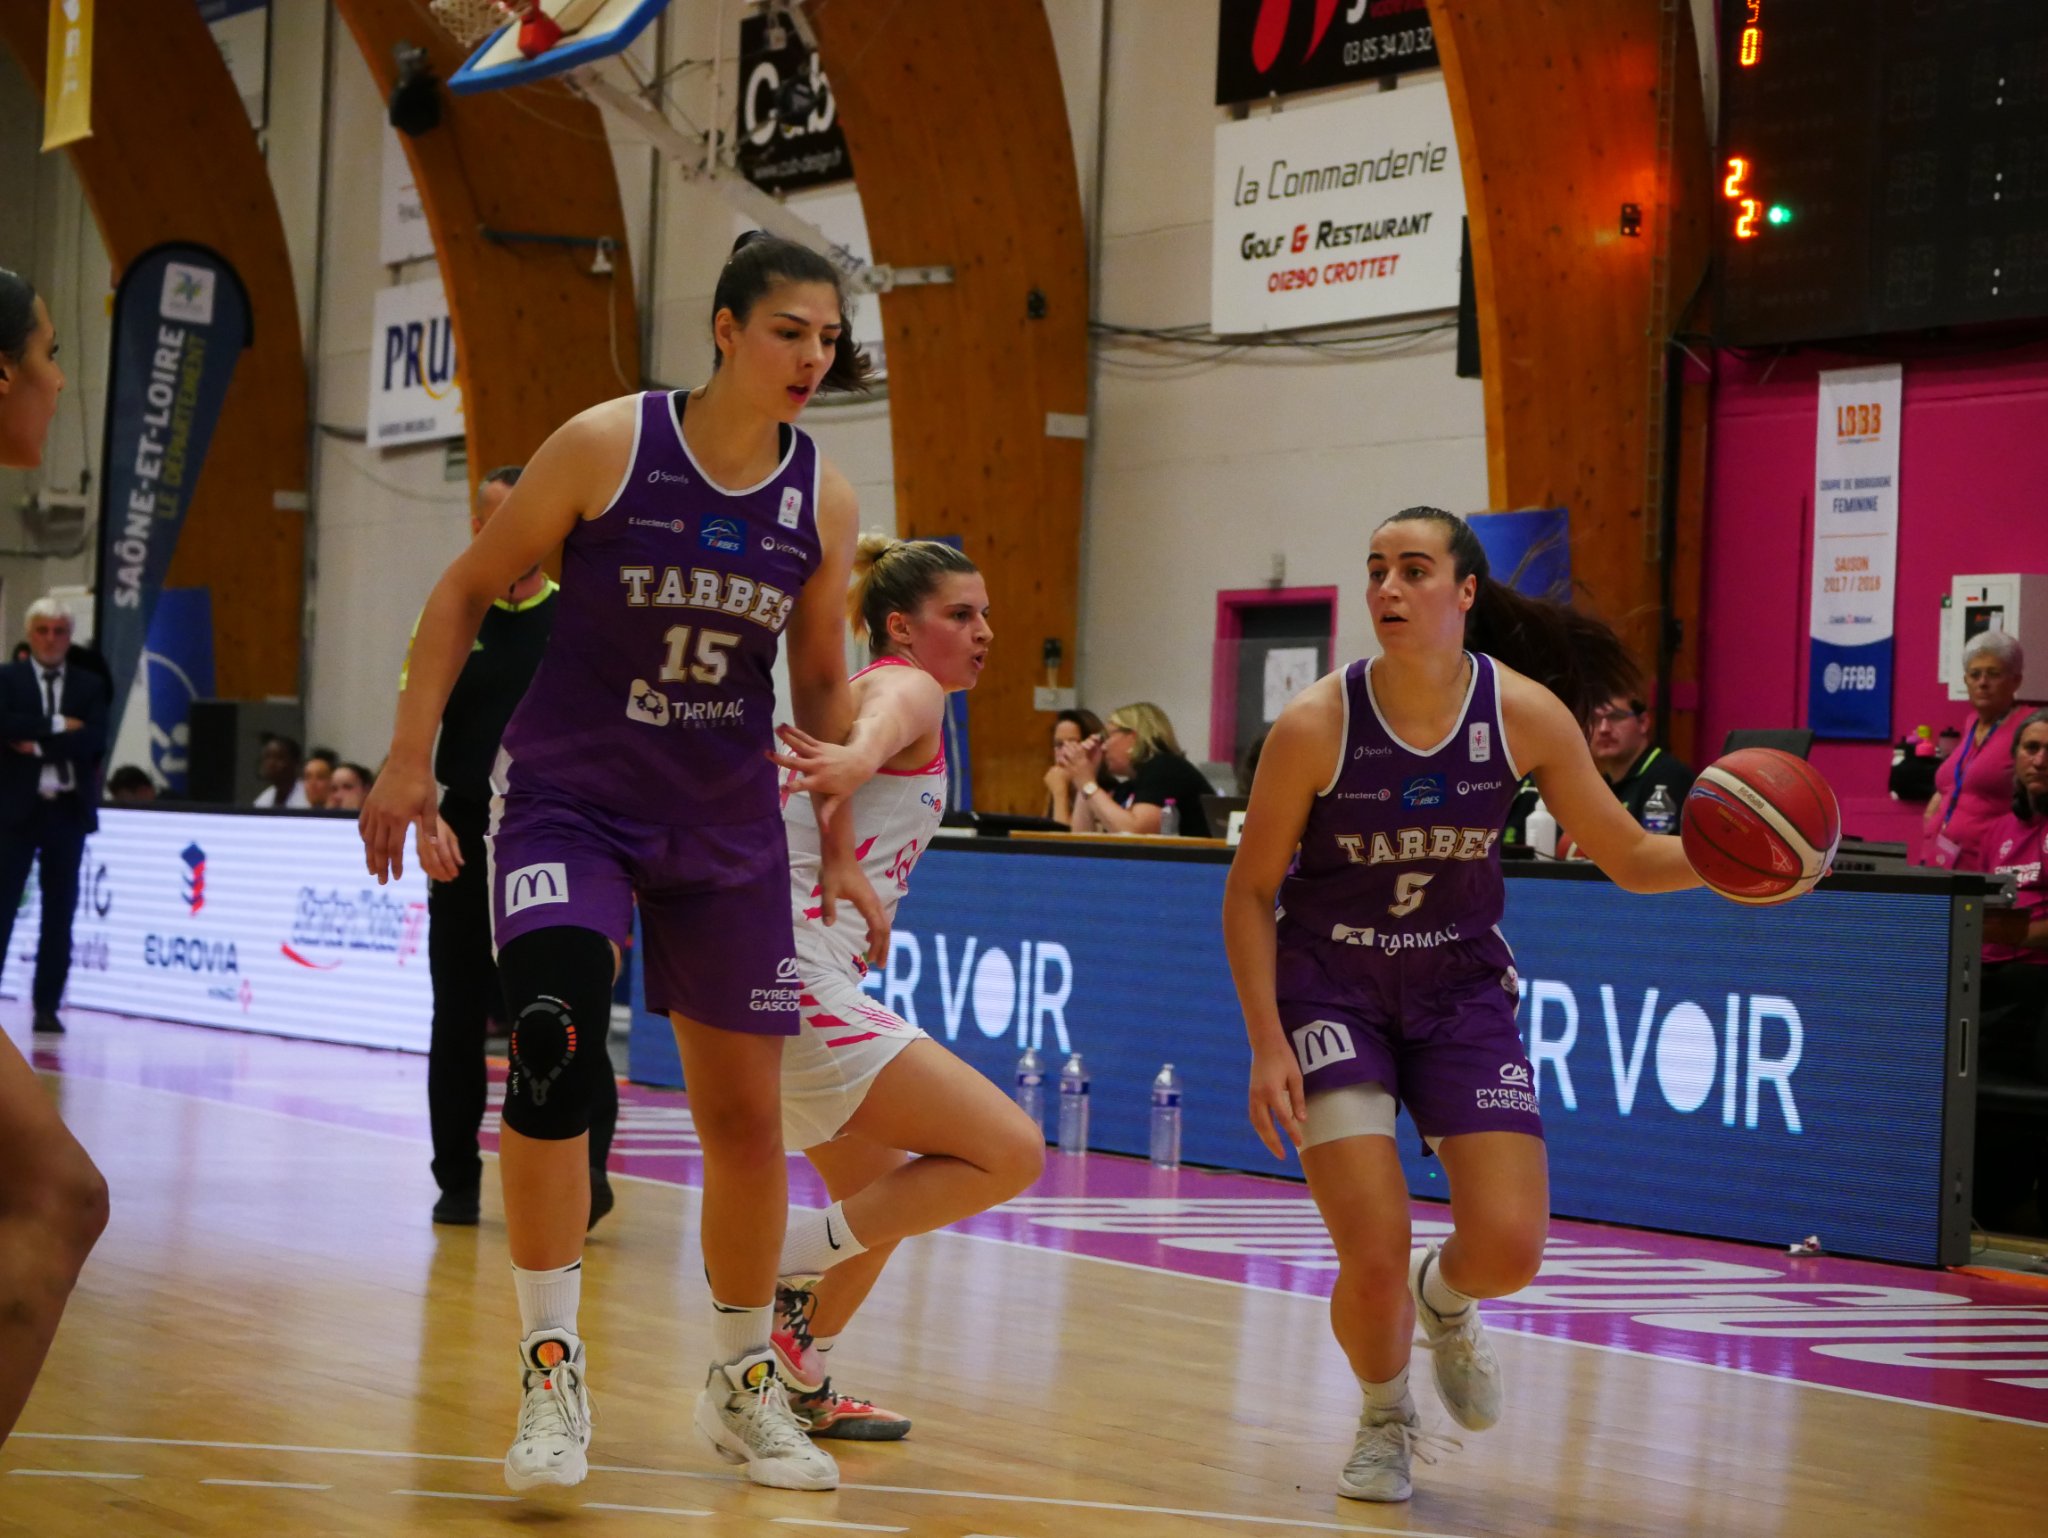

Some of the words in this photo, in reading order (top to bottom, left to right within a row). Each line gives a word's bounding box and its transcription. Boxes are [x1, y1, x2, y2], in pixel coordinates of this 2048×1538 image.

[1361, 37, 1378, 62] 85
[1379, 33, 1397, 59] 34
[1398, 29, 1415, 55] 20
[1267, 141, 1447, 200] Commanderie
[1315, 212, 1433, 250] RESTAURANT
[1267, 265, 1318, 294] 01290
[1323, 254, 1401, 285] CROTTET
[381, 314, 458, 392] PRU
[113, 323, 185, 609] SAÔNE-ET-LOIRE
[619, 565, 795, 633] TARBES
[658, 623, 743, 685] 15
[1841, 665, 1876, 691] FFBB
[671, 698, 745, 721] TARMAC
[1334, 826, 1499, 867] TARBES
[1387, 871, 1436, 919] 5
[144, 933, 239, 976] EUROVIA
[1377, 923, 1461, 950] TARMAC
[749, 1000, 800, 1012] GASCO
[1518, 978, 1579, 1113] R
